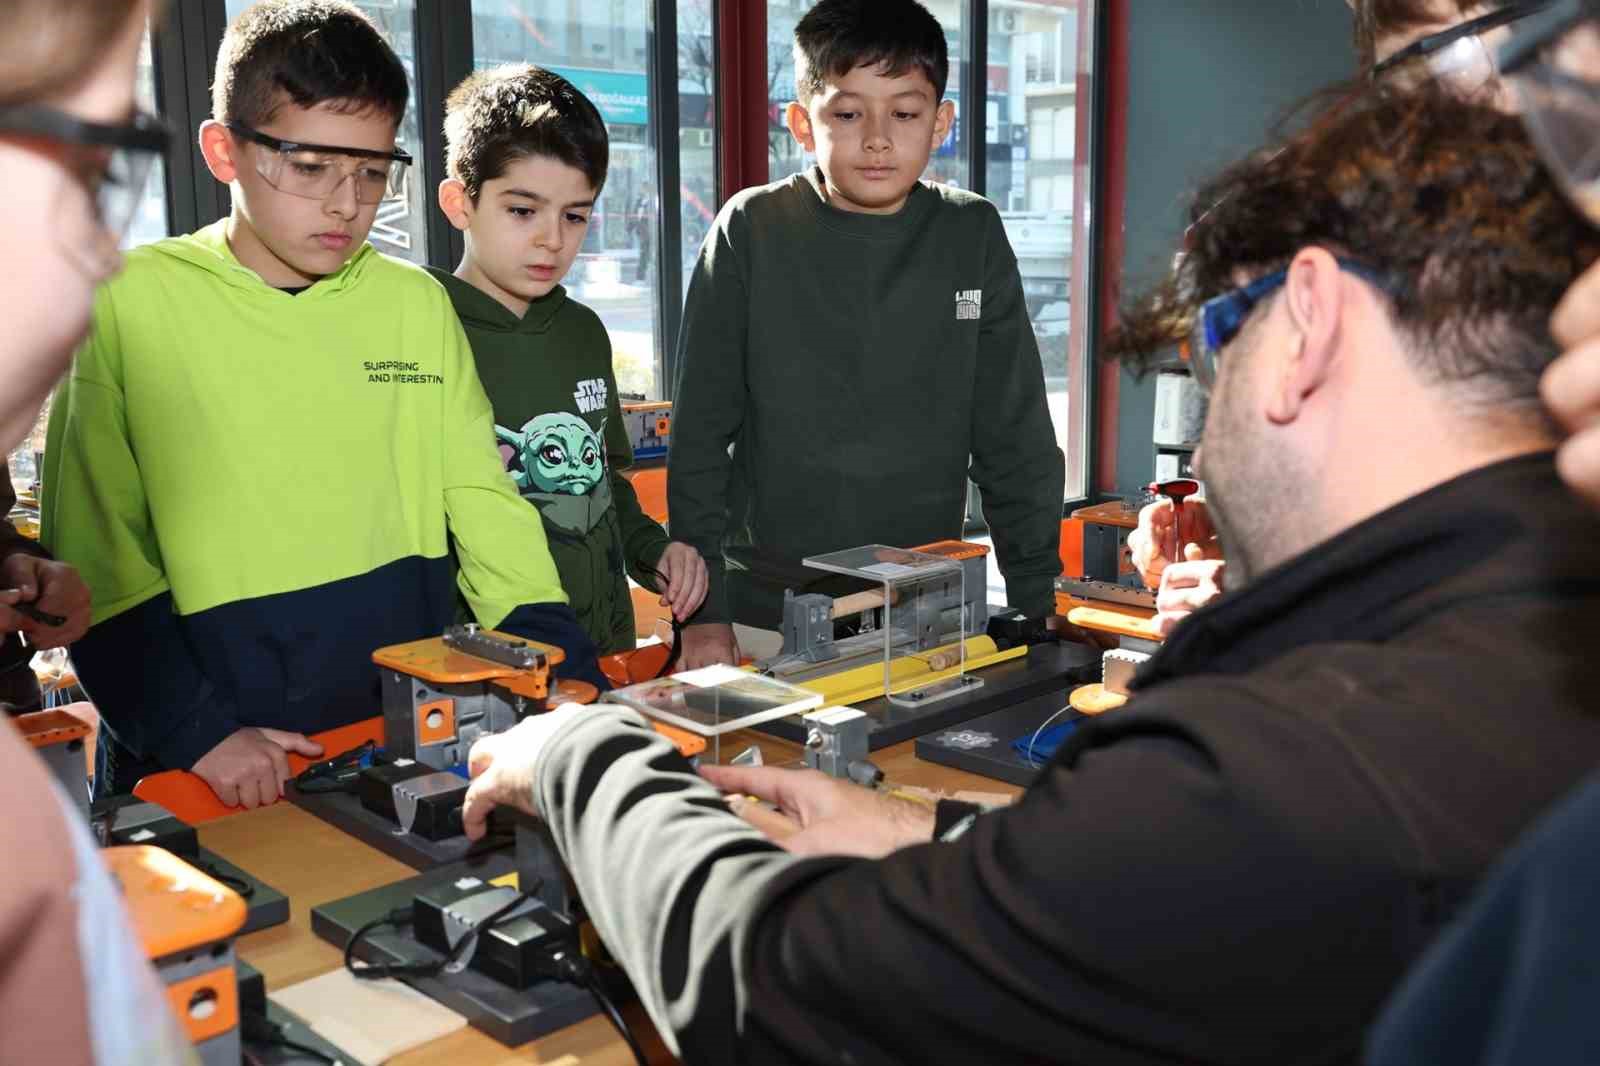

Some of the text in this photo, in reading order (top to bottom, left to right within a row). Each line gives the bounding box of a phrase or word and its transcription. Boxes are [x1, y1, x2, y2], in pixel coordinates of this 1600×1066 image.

[363, 361, 419, 371] SURPRSING
[368, 373, 390, 383] AND
[573, 378, 607, 398] STAR
